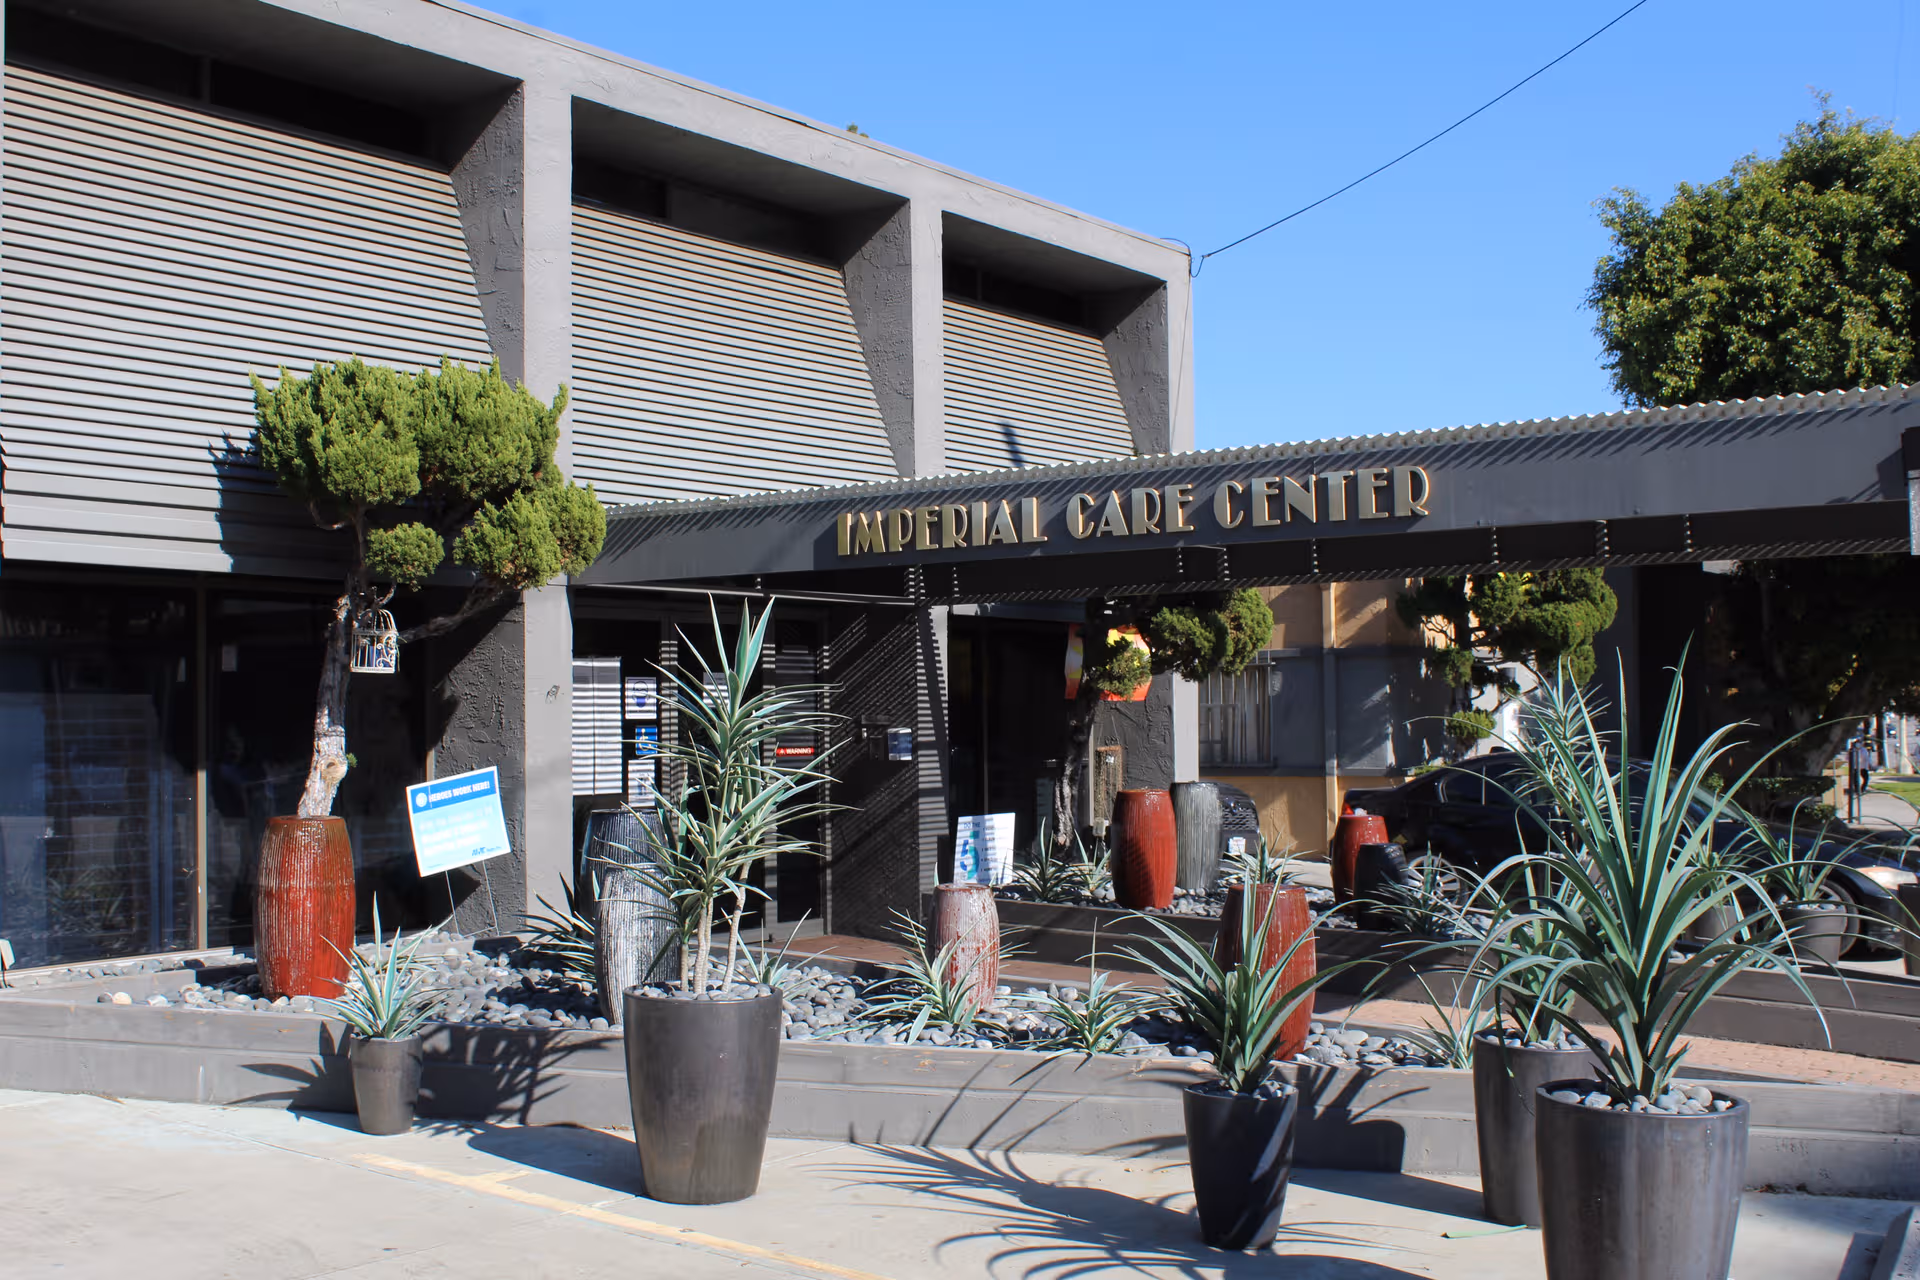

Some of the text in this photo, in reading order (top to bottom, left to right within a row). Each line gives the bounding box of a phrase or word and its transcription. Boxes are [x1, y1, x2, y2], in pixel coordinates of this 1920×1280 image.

[837, 465, 1430, 556] IMPERIAL CARE CENTER
[786, 747, 812, 755] WARNING
[429, 790, 453, 803] HEROES
[453, 785, 472, 797] WORK
